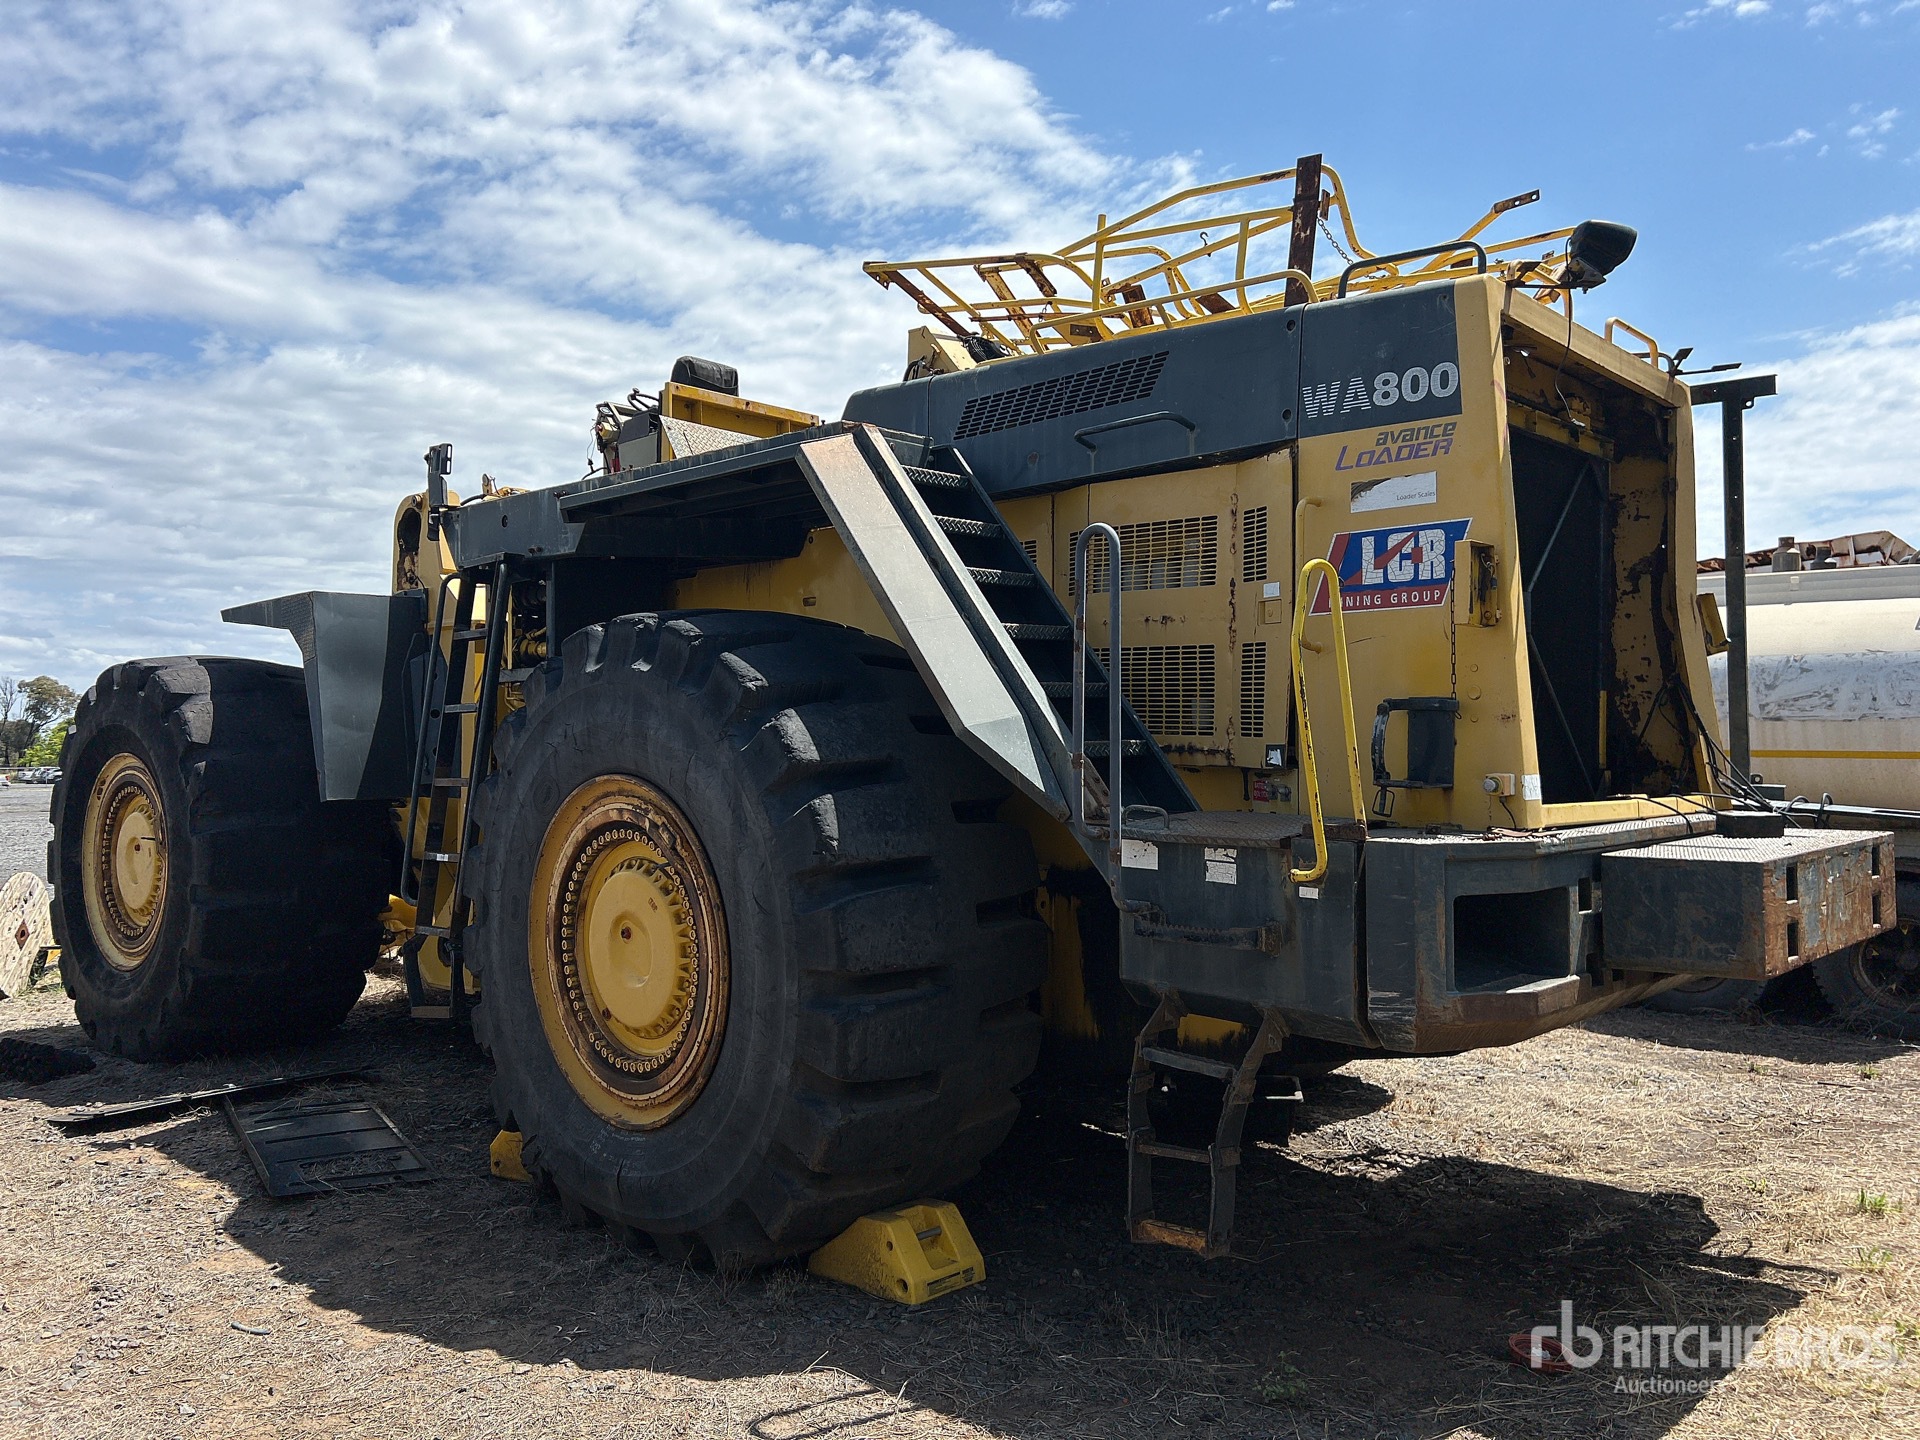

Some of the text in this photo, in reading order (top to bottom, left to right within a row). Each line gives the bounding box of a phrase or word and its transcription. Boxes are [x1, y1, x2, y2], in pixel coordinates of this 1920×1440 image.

[1302, 361, 1459, 419] WA800
[1375, 421, 1457, 446] avance
[1396, 490, 1436, 501] Loader Scales
[1361, 528, 1446, 586] LCR
[1390, 589, 1441, 604] GROUP
